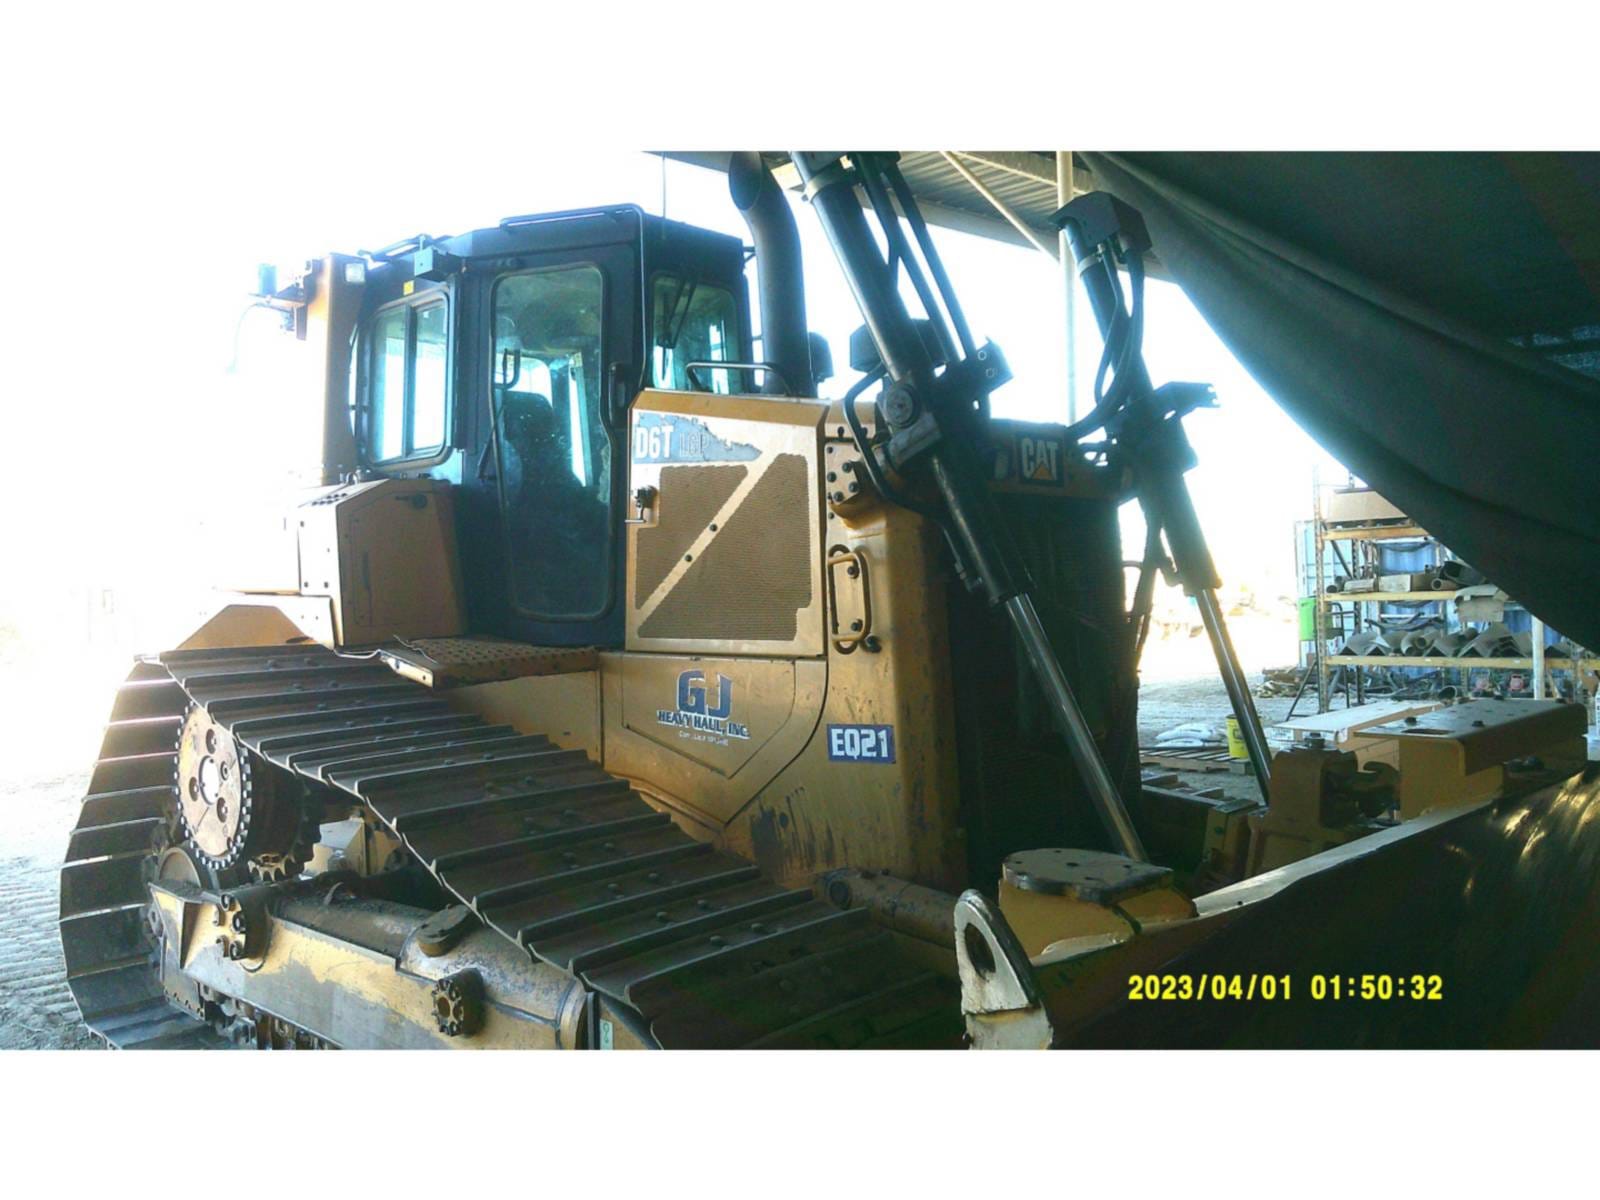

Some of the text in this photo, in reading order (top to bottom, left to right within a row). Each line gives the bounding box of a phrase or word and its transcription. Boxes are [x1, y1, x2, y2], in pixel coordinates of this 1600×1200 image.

[635, 425, 674, 459] D6T
[1021, 438, 1058, 480] CAT
[676, 669, 733, 720] GJ
[656, 709, 691, 728] HEAVY
[692, 713, 726, 735] HAUL,
[830, 728, 888, 760] EQ21
